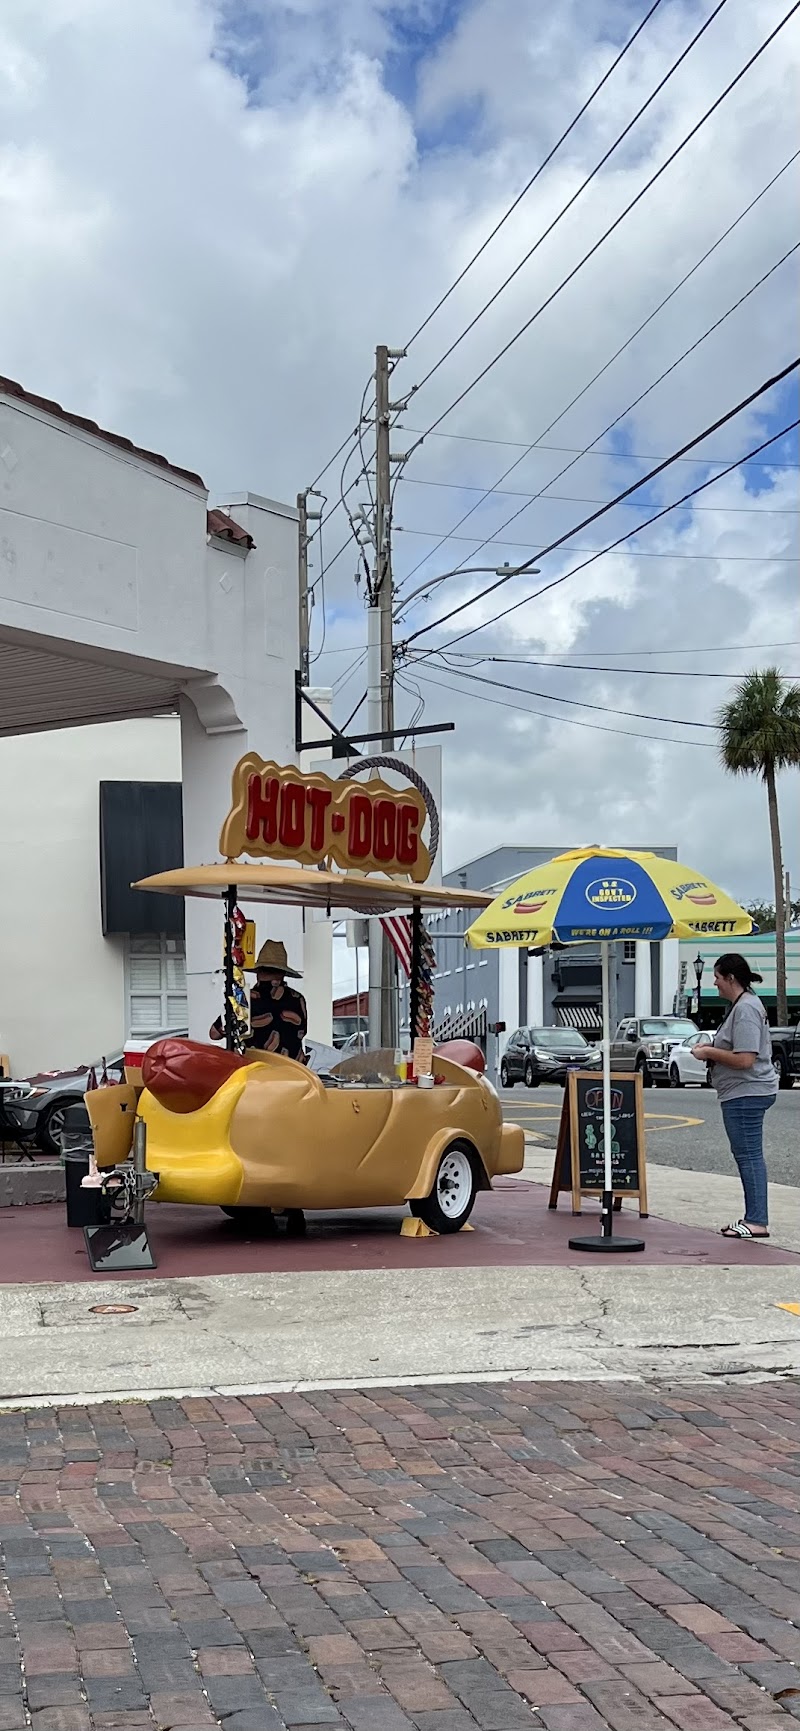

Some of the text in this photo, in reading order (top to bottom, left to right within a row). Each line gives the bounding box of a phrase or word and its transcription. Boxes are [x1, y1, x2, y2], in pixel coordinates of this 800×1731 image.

[501, 889, 558, 909] SABRETT
[591, 895, 632, 903] INSPECTED
[670, 882, 708, 901] SABRETT
[486, 930, 539, 943] SABRETT
[598, 928, 612, 937] ON
[612, 927, 619, 936] A
[620, 927, 640, 935] ROLL
[586, 1090, 623, 1108] OPN
